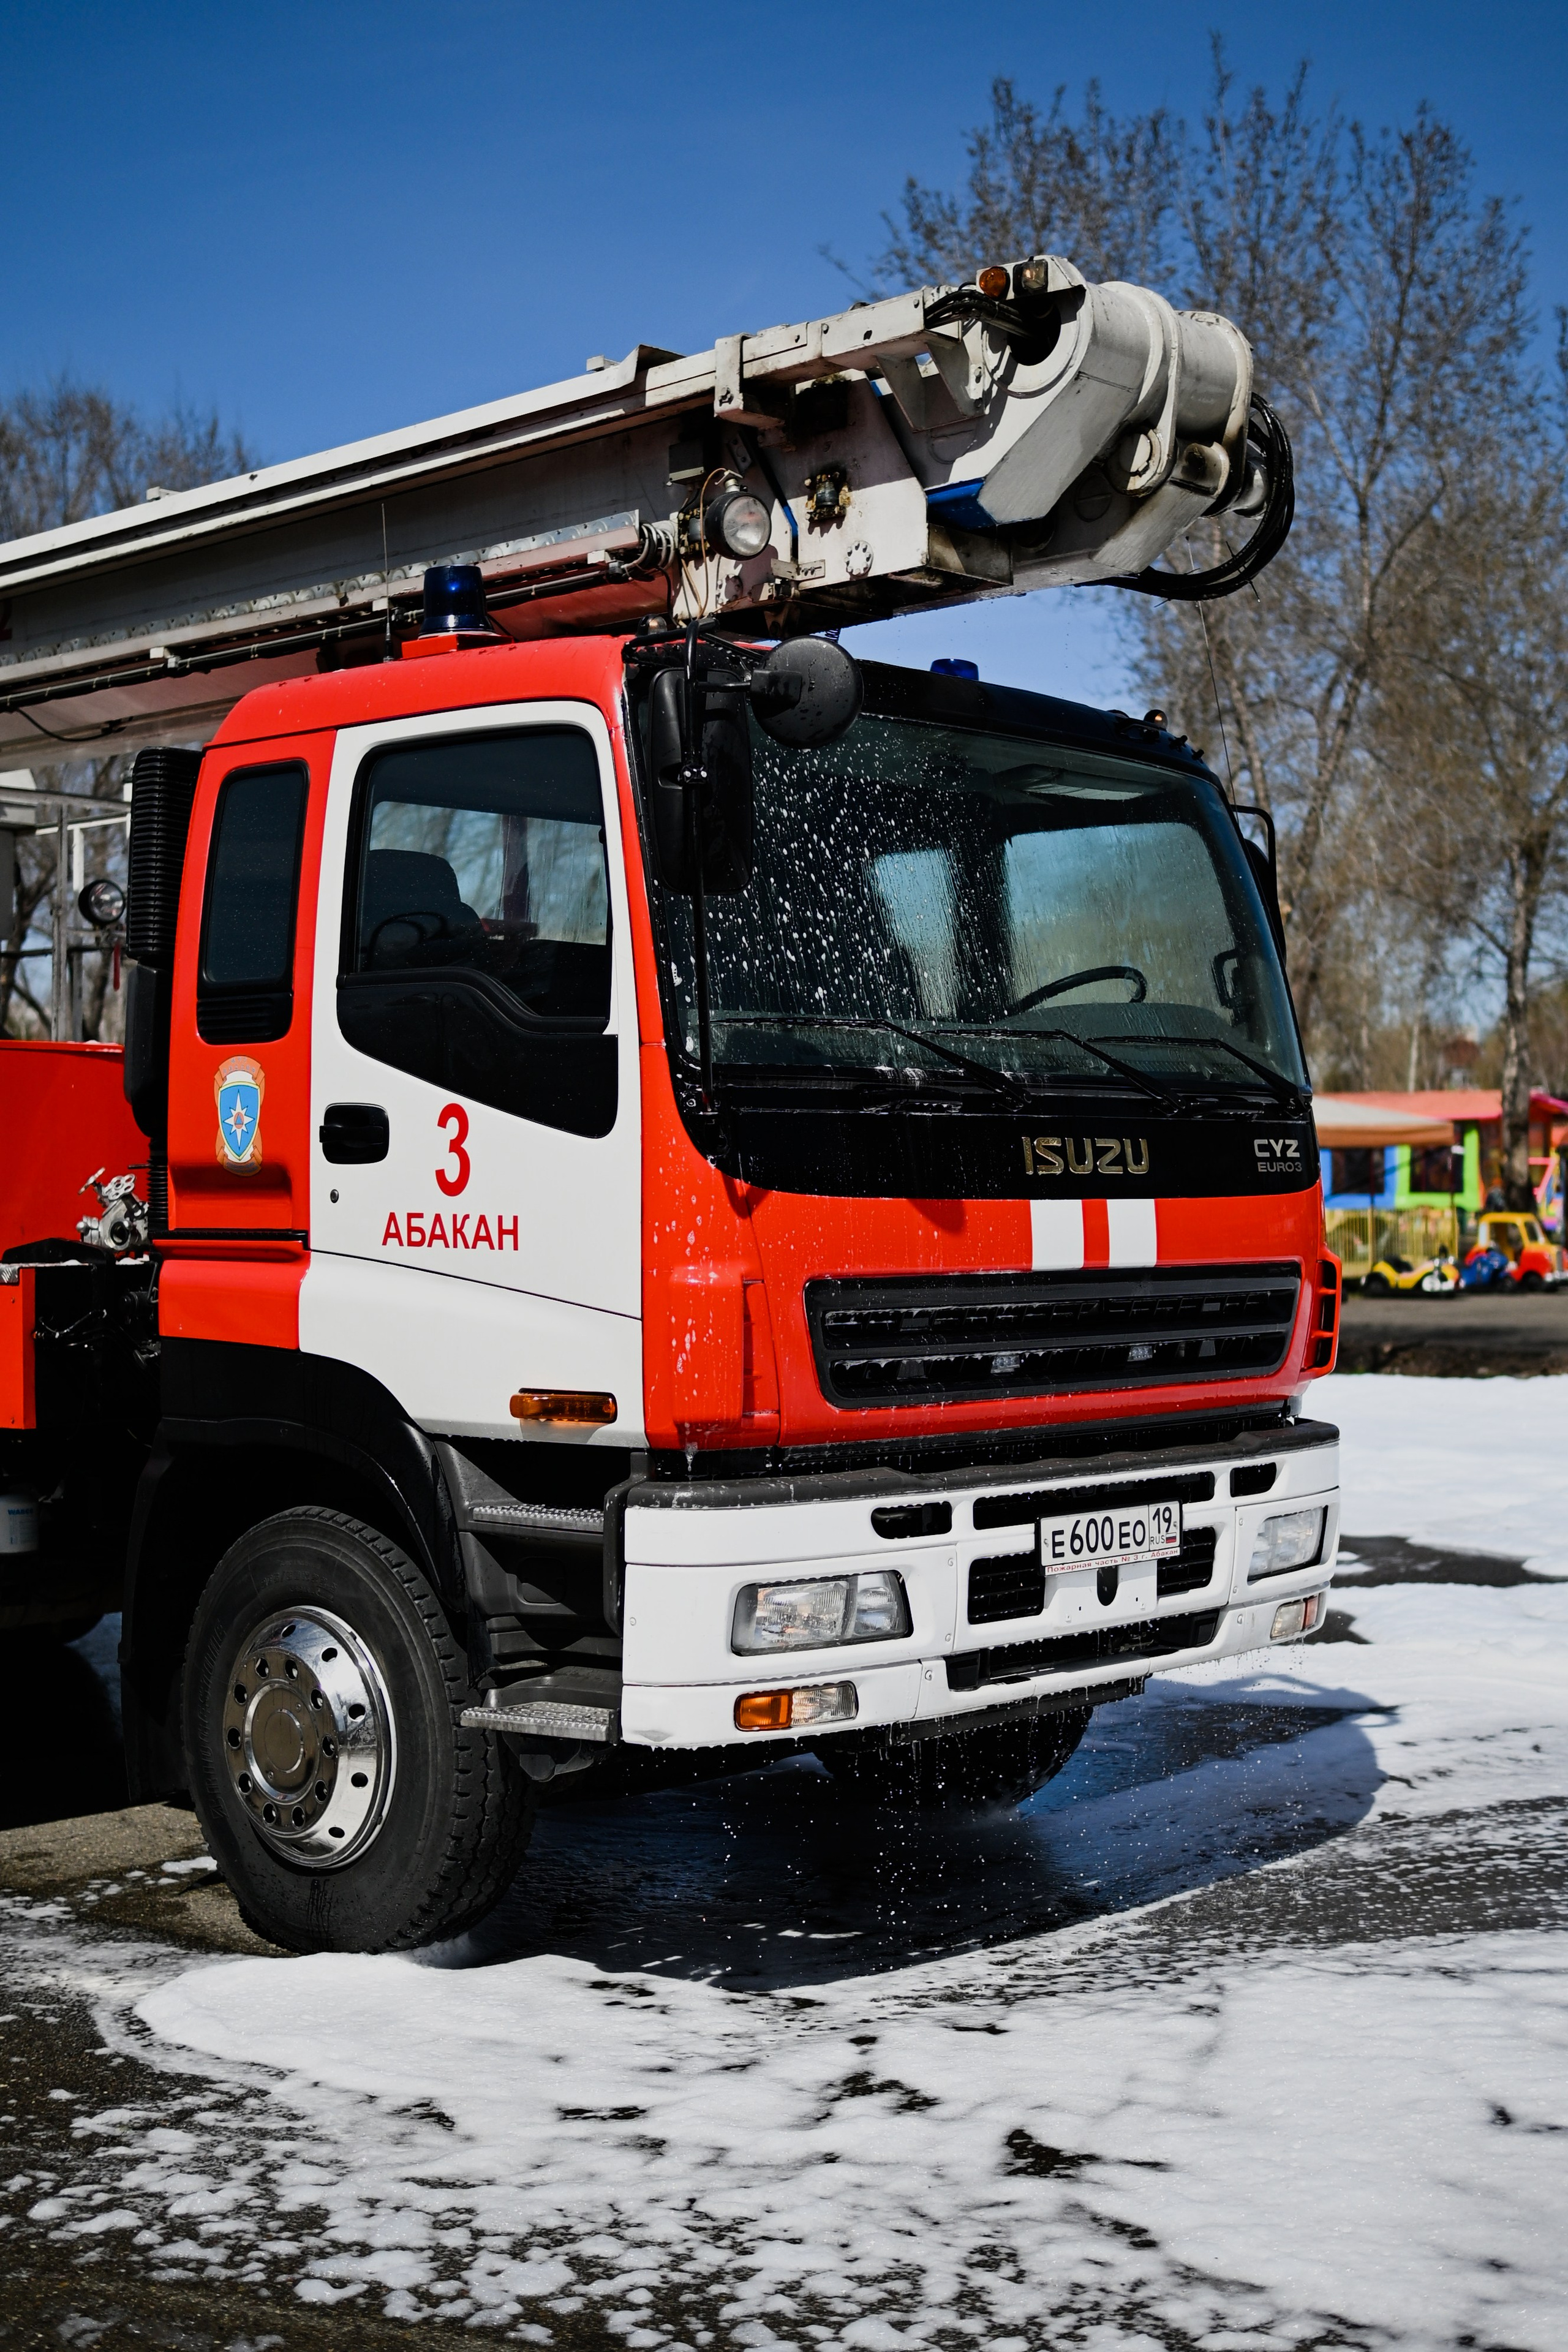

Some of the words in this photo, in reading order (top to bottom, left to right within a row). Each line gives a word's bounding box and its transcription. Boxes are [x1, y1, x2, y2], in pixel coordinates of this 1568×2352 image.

[435, 1103, 470, 1196] 3
[1021, 1137, 1149, 1175] ISUZU
[1253, 1139, 1300, 1158] CYZ
[1257, 1162, 1303, 1173] EURO3
[382, 1212, 519, 1251] АБАКАН
[1152, 1506, 1172, 1534] 19
[1150, 1535, 1166, 1545] RUS
[1047, 1562, 1091, 1573] Пожарная
